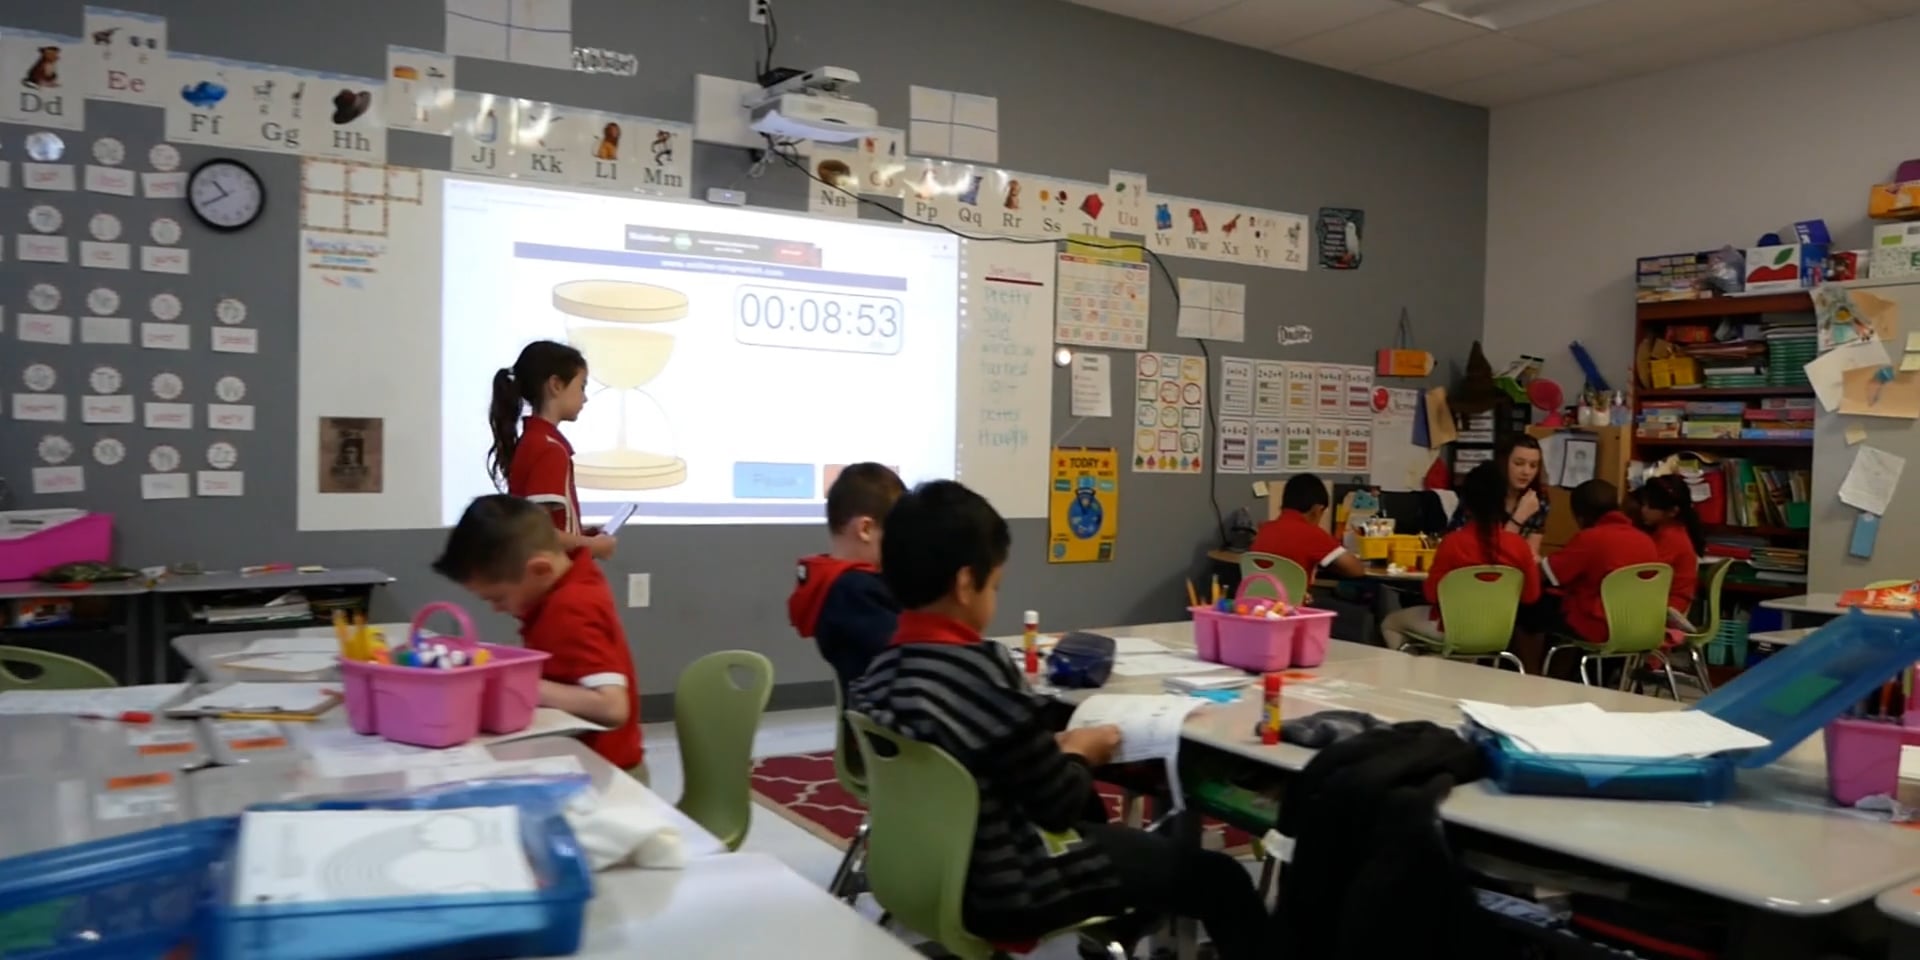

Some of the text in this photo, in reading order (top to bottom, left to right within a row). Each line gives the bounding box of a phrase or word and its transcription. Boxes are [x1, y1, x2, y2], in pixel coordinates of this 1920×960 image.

[107, 70, 146, 93] Ee
[20, 93, 63, 116] Dd
[190, 113, 225, 135] Ff
[261, 121, 301, 148] Gg
[333, 129, 371, 152] Hh
[472, 146, 497, 170] Jj
[531, 153, 564, 175] Kk
[595, 161, 617, 181] Ll
[643, 166, 683, 189] Mm
[820, 189, 848, 209] Nn
[915, 202, 938, 222] Pp
[958, 207, 983, 228] Qq
[1002, 212, 1023, 229] Rr
[1117, 210, 1139, 227] Uu
[1043, 217, 1062, 234] Ss
[1082, 222, 1098, 237] Tt
[1185, 236, 1210, 252] Ww
[1220, 241, 1241, 257] Xx
[1254, 245, 1272, 262] Yy
[1284, 249, 1301, 264] Zz
[740, 292, 898, 339] 00:08:53
[1069, 457, 1099, 469] TODAY
